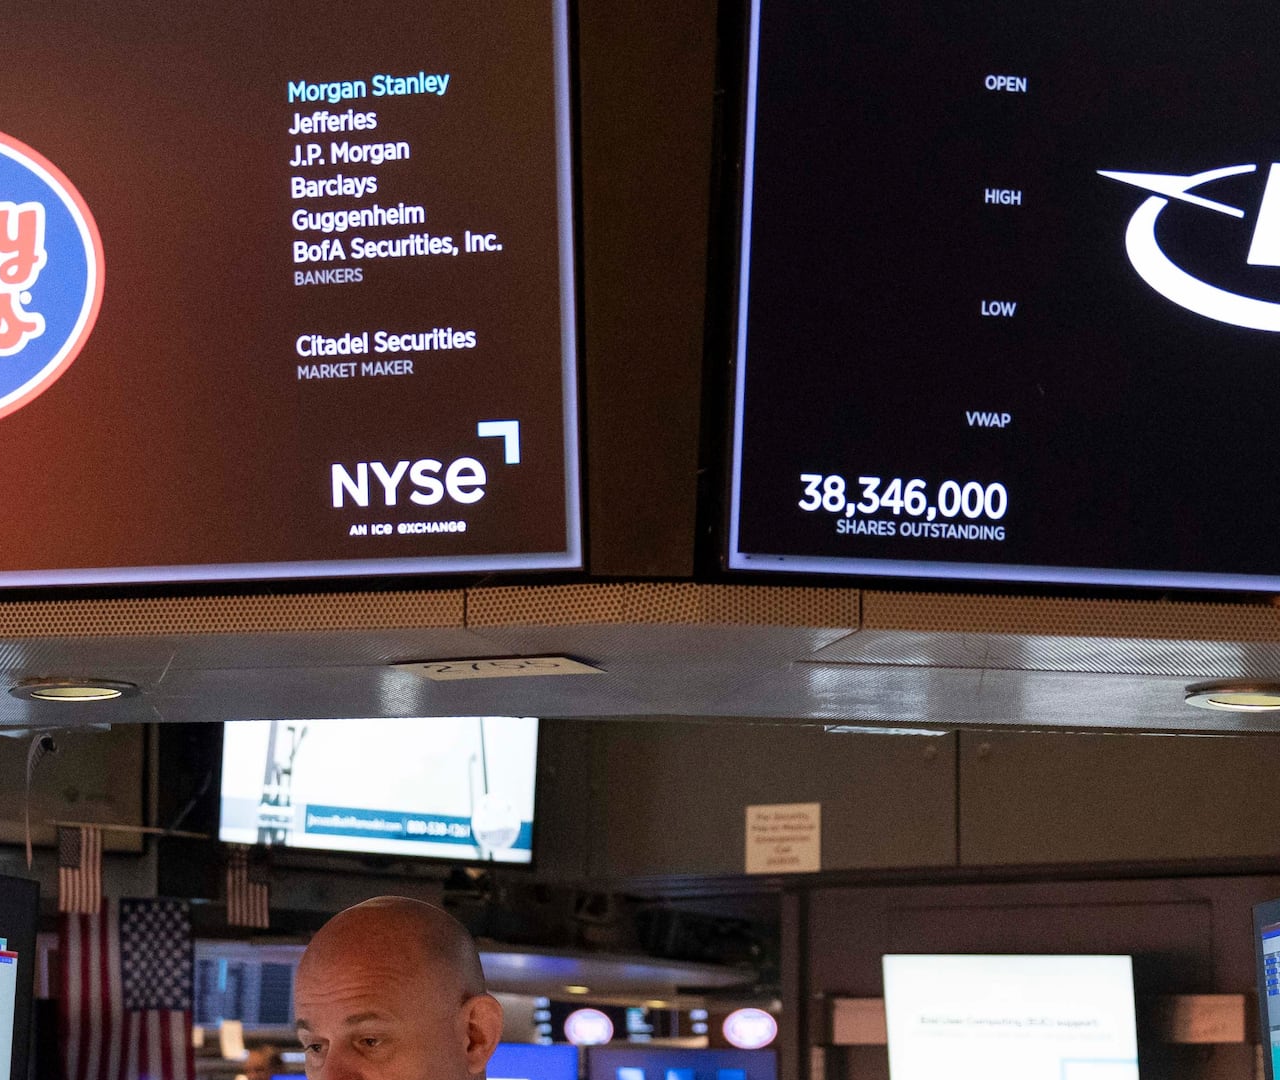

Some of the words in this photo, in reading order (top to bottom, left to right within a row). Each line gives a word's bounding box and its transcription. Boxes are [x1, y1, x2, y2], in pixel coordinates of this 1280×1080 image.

[287, 79, 366, 104] Morgan
[372, 71, 450, 97] Stanley
[984, 74, 1027, 93] OPEN
[288, 109, 377, 135] Jefferies
[289, 144, 325, 166] J.P.
[330, 141, 410, 165] Morgan
[291, 174, 377, 199] Barclays
[984, 188, 1021, 205] HIGH
[291, 203, 425, 233] Guggenheim
[293, 239, 346, 263] BofA
[350, 234, 458, 259] Securities,
[464, 230, 503, 253] Inc.
[294, 267, 363, 286] BANKERS
[981, 301, 1016, 317] LOW
[296, 333, 369, 357] Citadel
[374, 327, 476, 353] Securities
[297, 362, 357, 380] MARKET
[361, 360, 413, 376] MAKER
[965, 411, 1011, 428] VWAP
[798, 473, 1008, 521] 38,346,000
[349, 524, 367, 536] AN
[836, 518, 896, 537] SHARES
[899, 521, 1006, 541] OUTSTANDING
